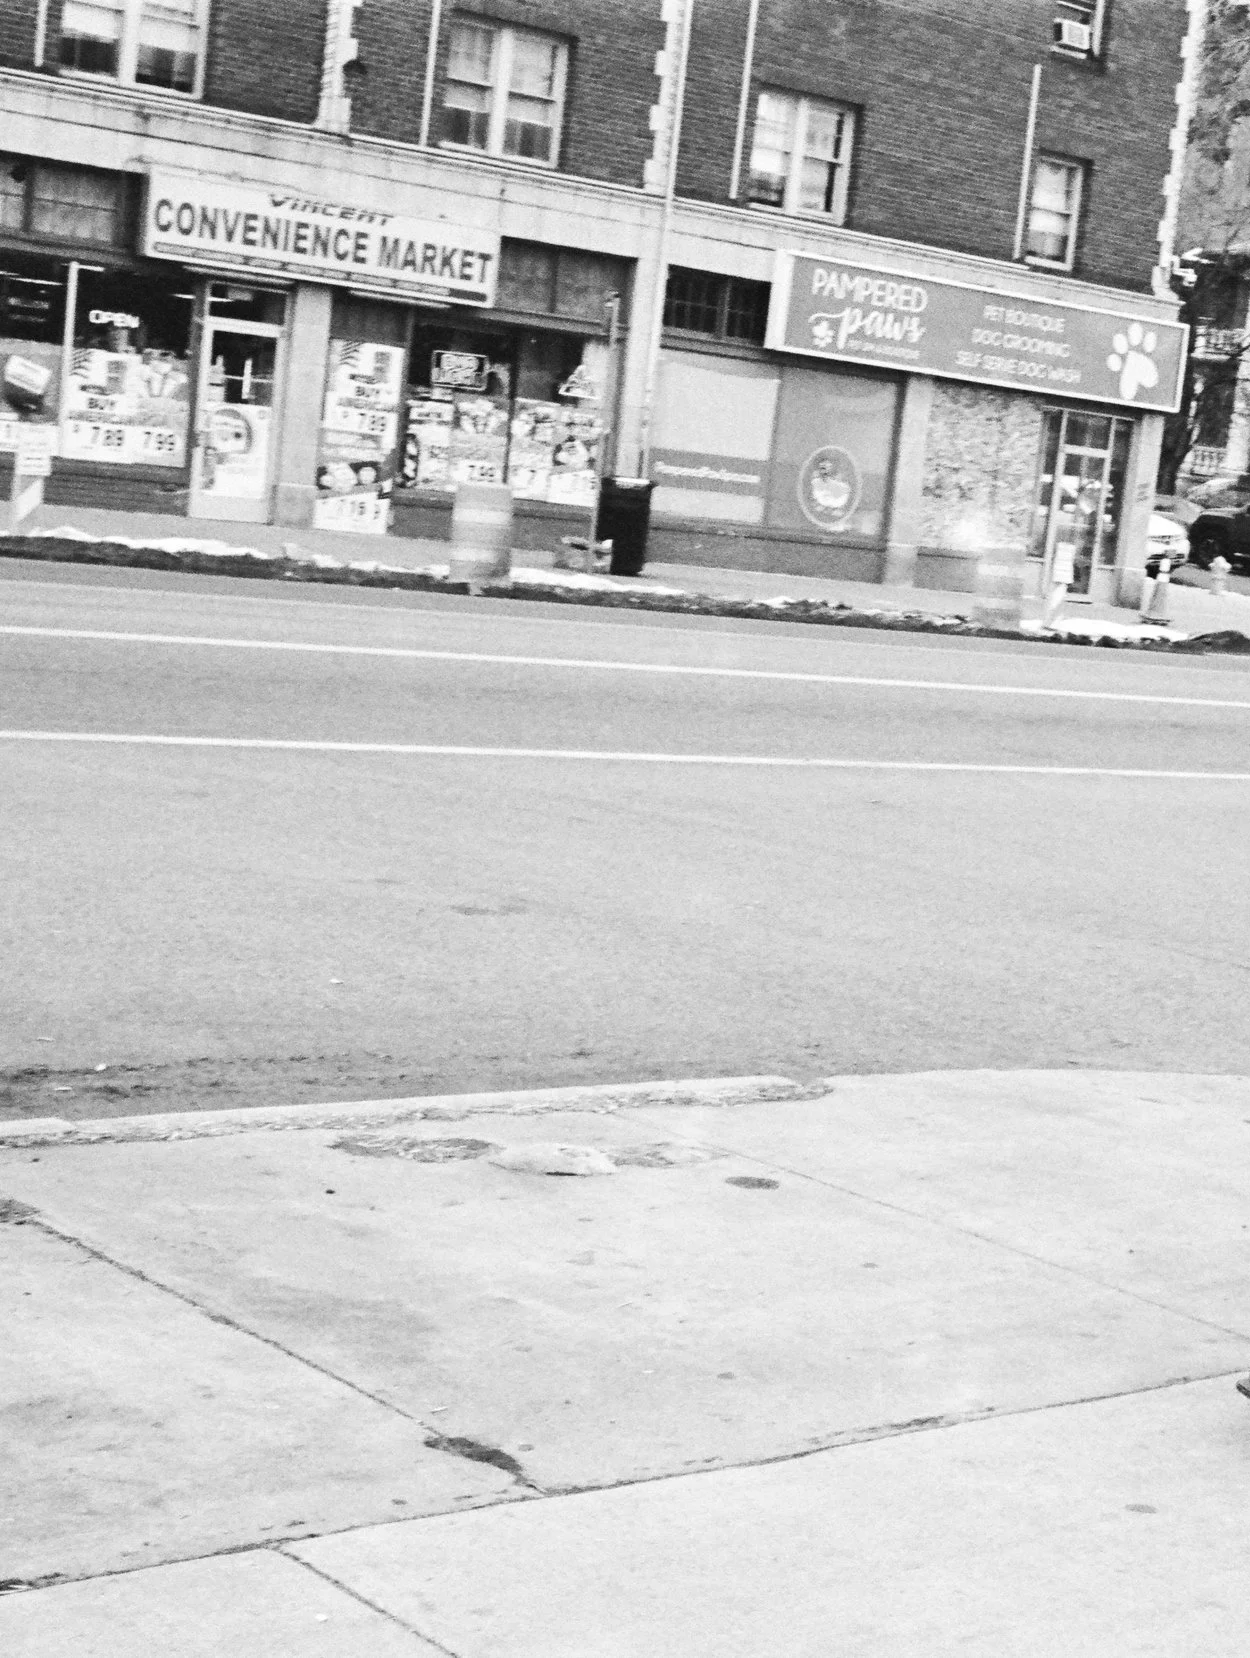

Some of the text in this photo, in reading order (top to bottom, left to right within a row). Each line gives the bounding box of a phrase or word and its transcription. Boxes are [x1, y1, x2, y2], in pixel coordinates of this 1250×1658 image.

[154, 198, 492, 284] CONVENIENCE MARKET
[811, 267, 929, 313] PAMPERED
[89, 310, 140, 329] OPEN
[970, 328, 1072, 359] DOG GROOMING
[1018, 360, 1047, 379] DOG
